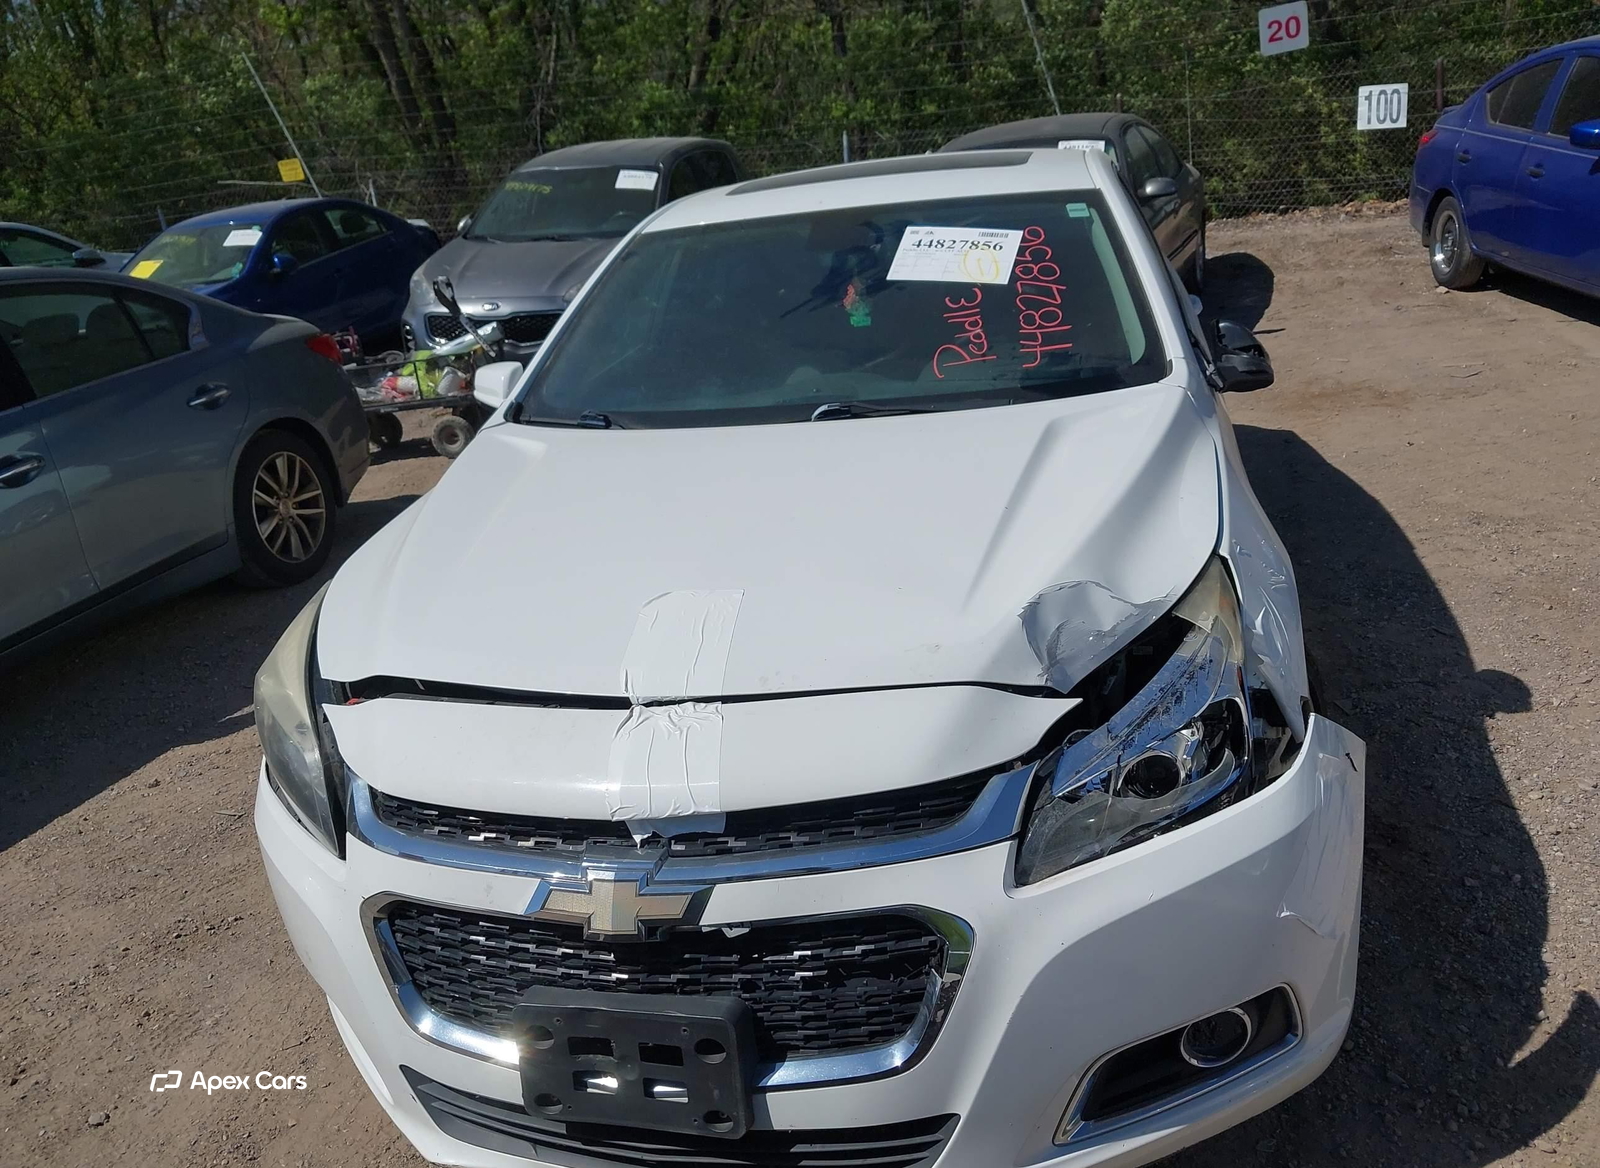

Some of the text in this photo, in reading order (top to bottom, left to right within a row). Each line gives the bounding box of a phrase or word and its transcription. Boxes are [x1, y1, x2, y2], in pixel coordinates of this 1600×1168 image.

[1267, 15, 1302, 43] 20
[1364, 88, 1402, 125] 100
[911, 238, 1004, 252] 44827856
[1014, 225, 1073, 368] 44827856
